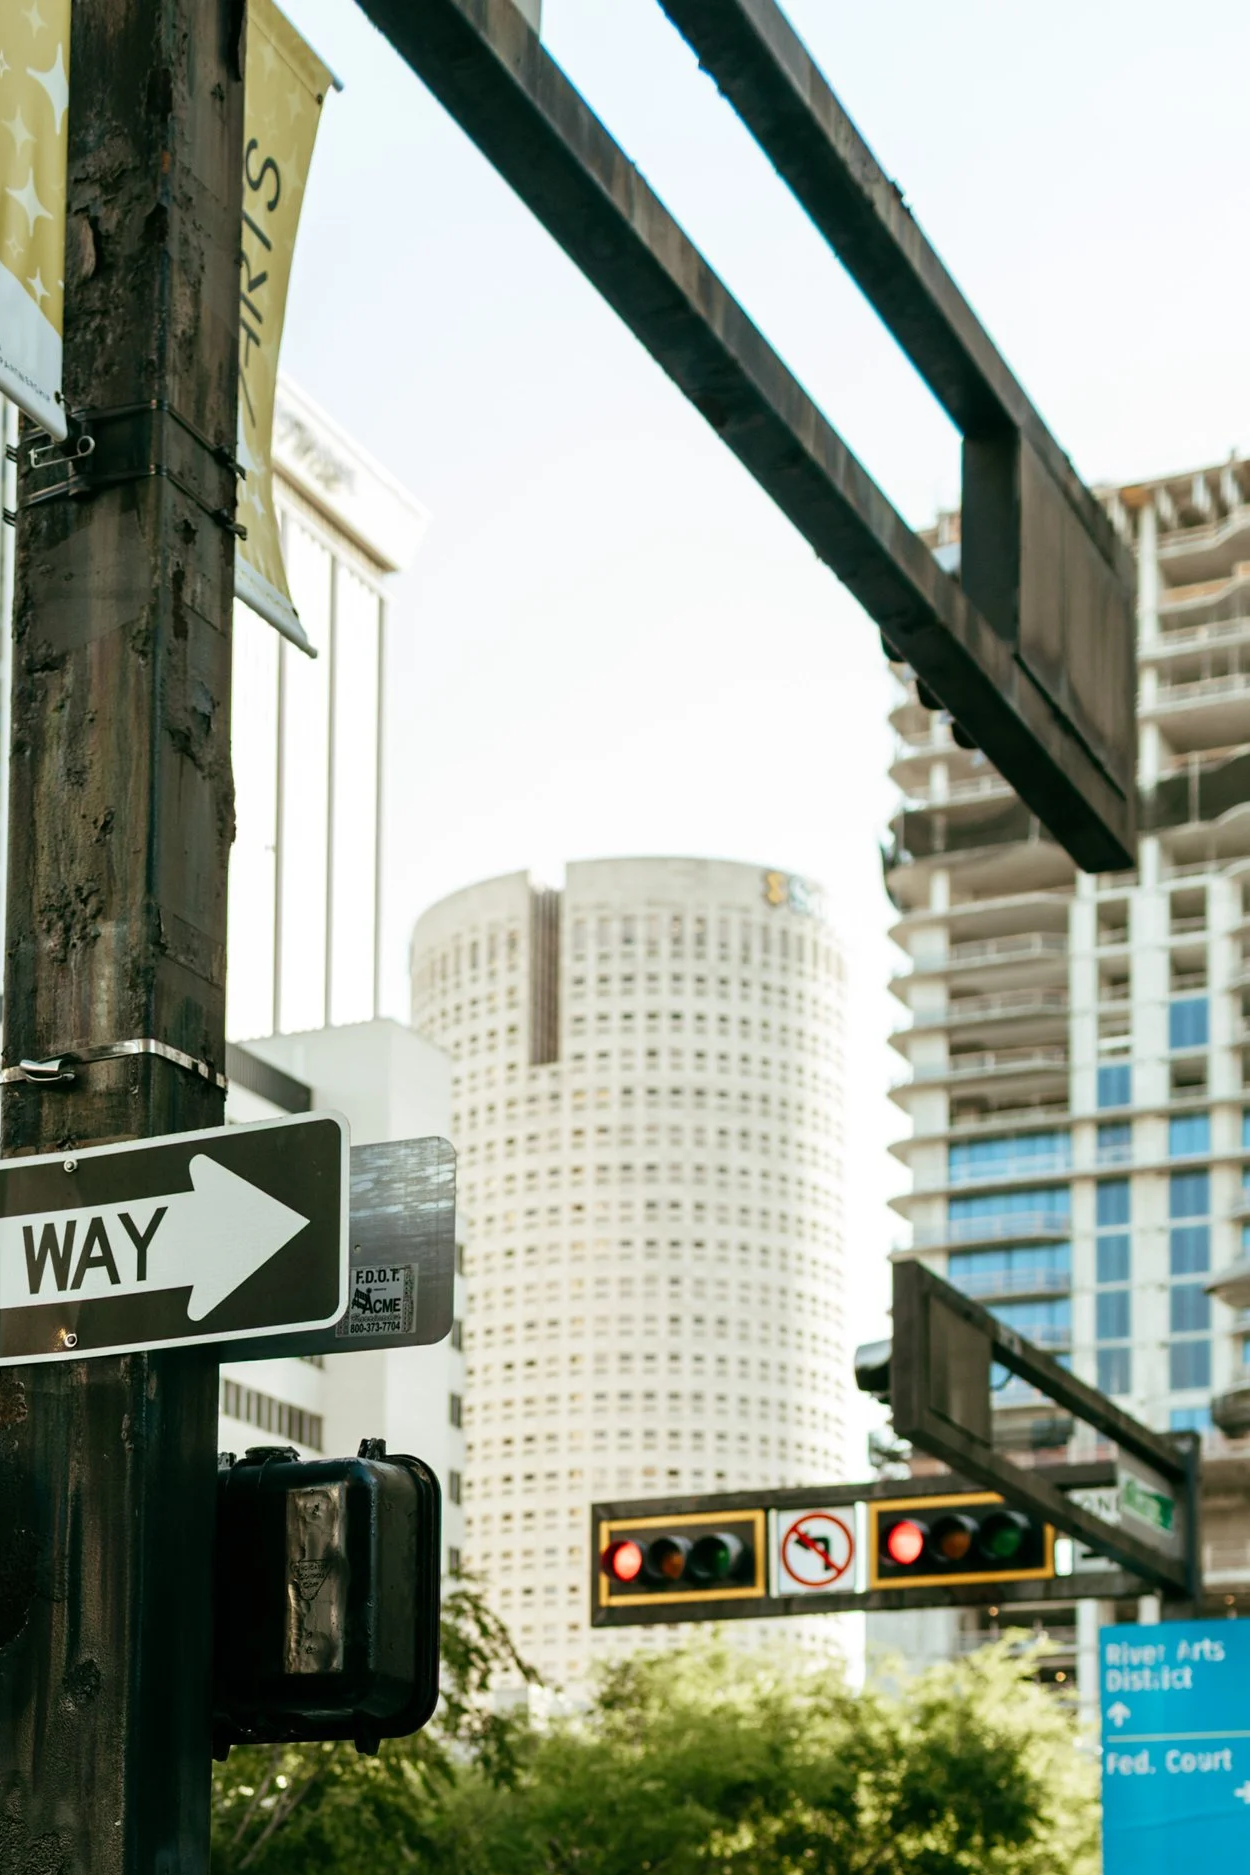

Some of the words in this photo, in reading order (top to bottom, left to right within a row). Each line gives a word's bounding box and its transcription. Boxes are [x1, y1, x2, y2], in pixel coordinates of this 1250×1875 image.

[22, 1206, 169, 1295] WAY
[355, 1268, 400, 1285] F.D.O.T.
[362, 1294, 402, 1315] ACME
[350, 1321, 400, 1334] 800-373-7704
[1106, 1641, 1166, 1667] River
[1176, 1637, 1226, 1663] Arts
[1106, 1665, 1193, 1693] District
[1106, 1748, 1157, 1776] Fed.
[1165, 1747, 1233, 1774] Court
